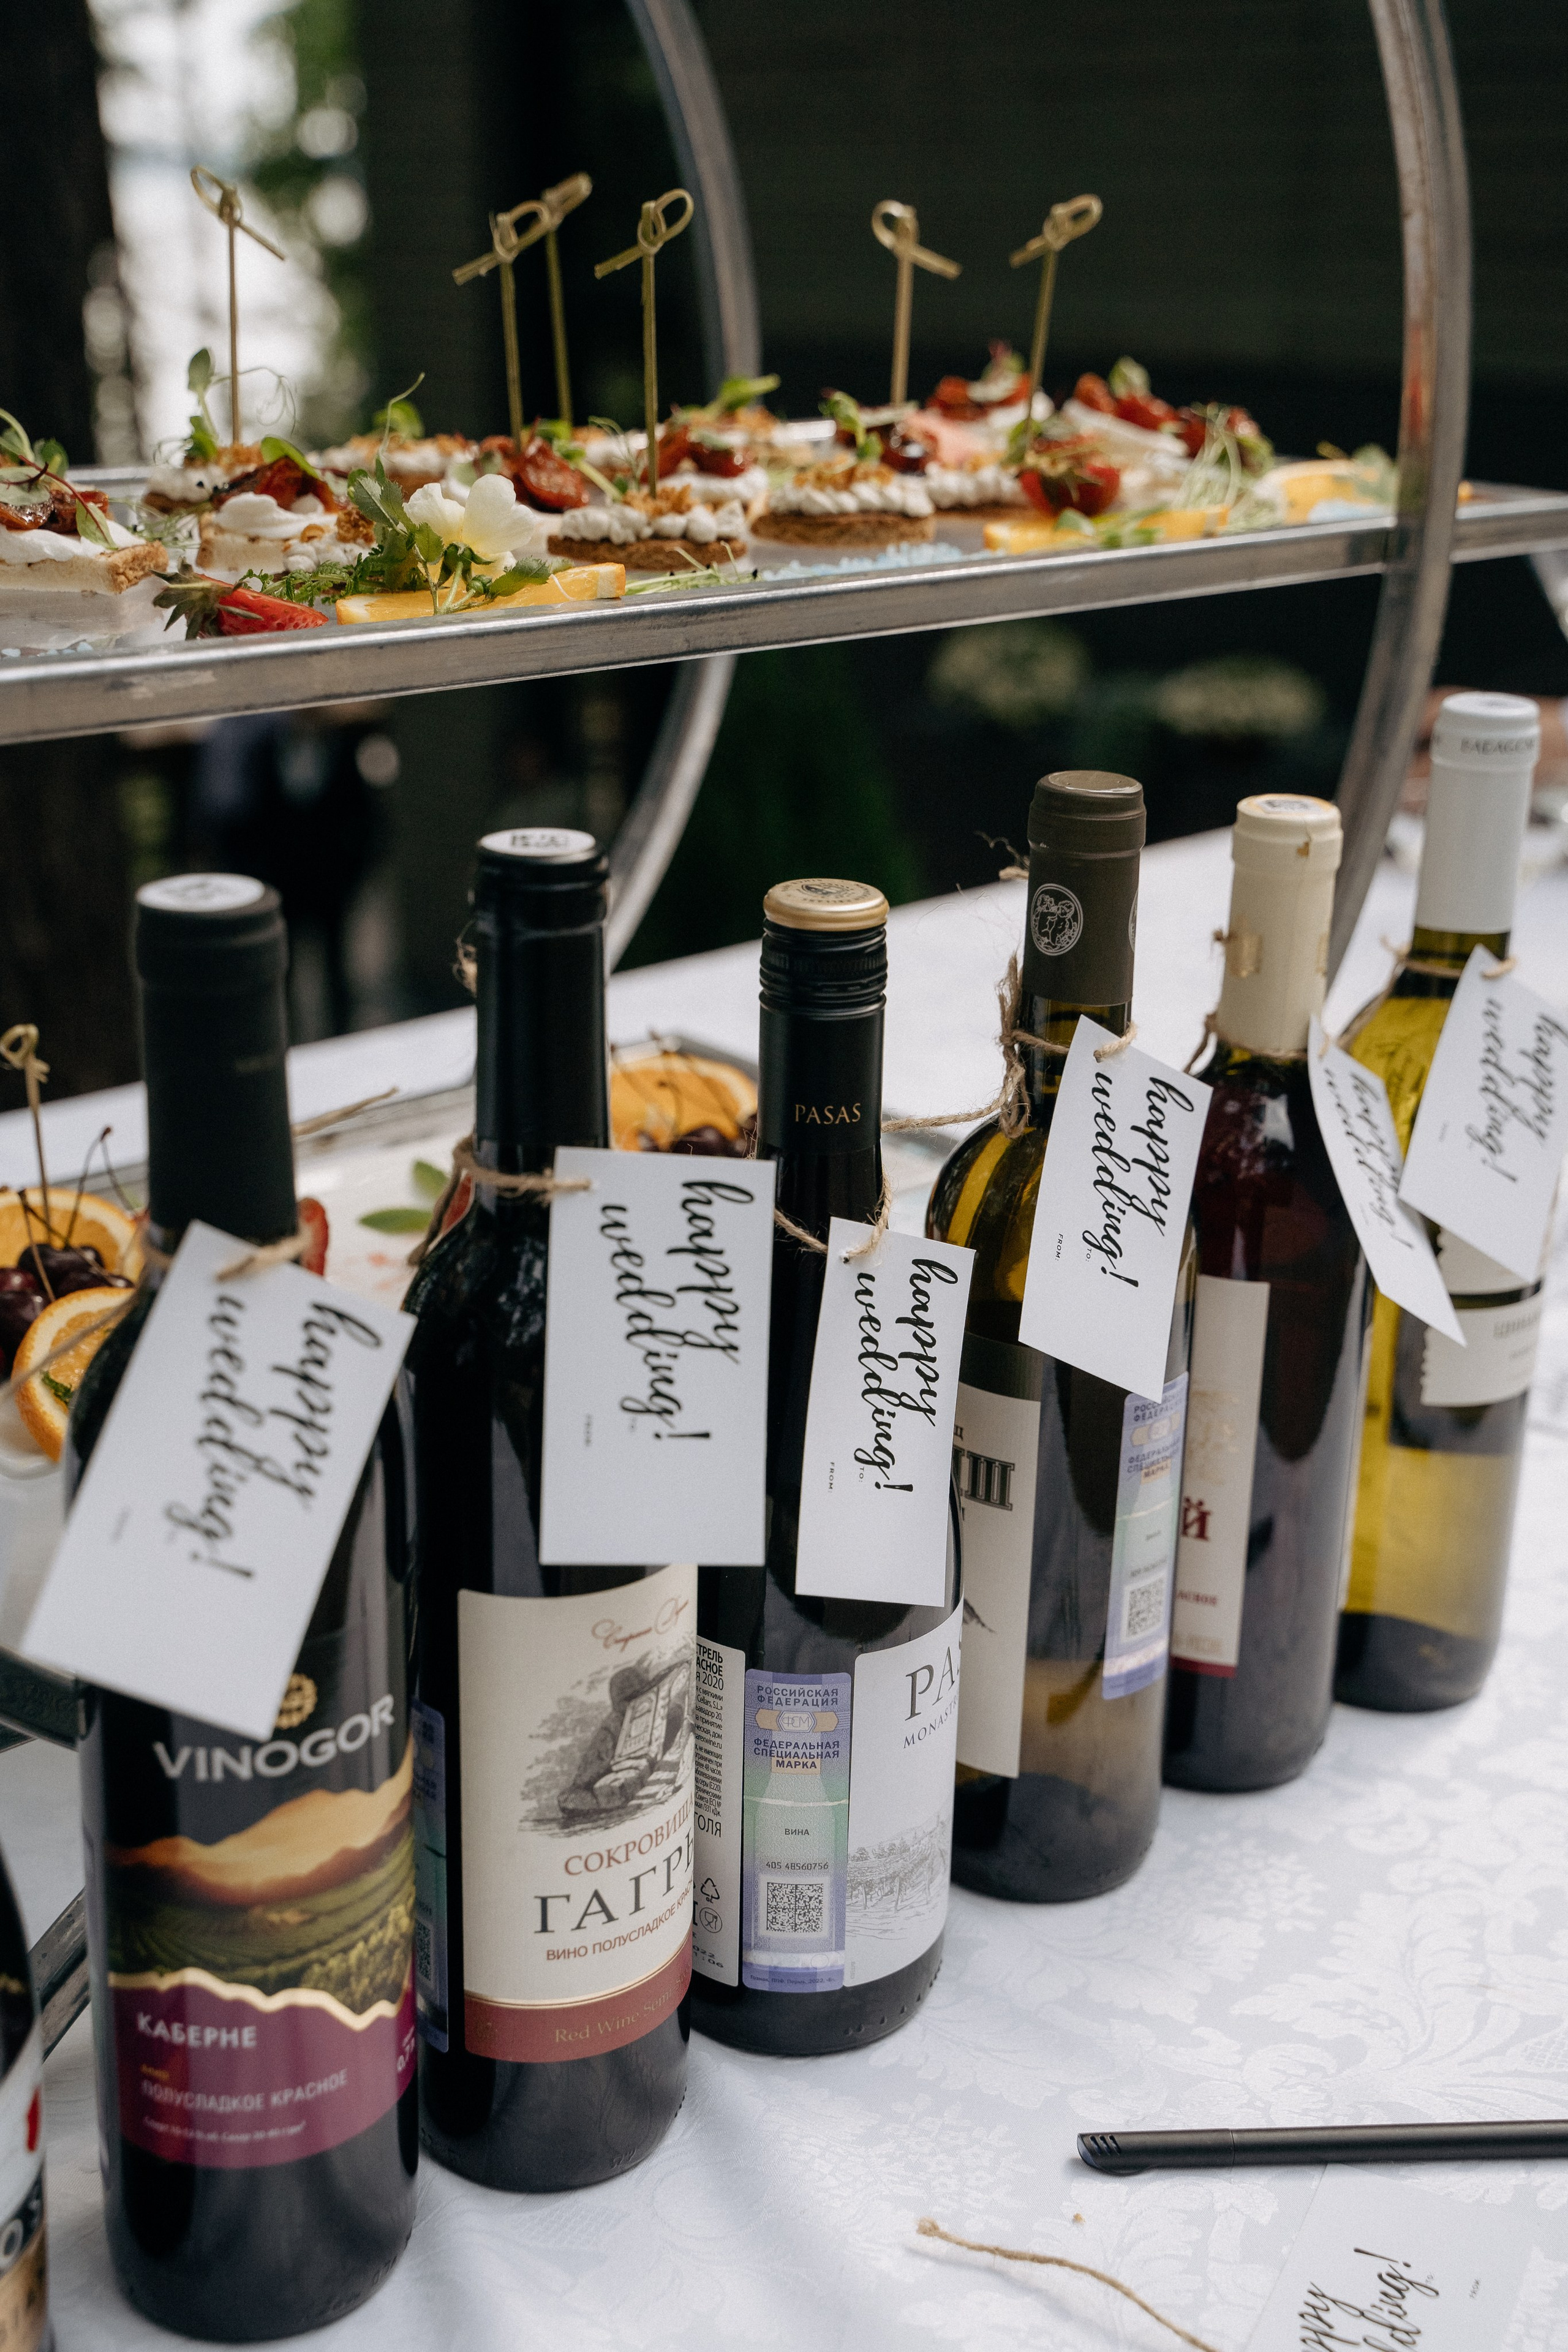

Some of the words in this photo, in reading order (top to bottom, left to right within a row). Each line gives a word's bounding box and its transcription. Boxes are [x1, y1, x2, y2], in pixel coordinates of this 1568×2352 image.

[796, 1103, 862, 1125] PASAS
[1130, 1076, 1194, 1237] happy
[1082, 1071, 1139, 1287] wedding!
[1055, 1233, 1063, 1261] FROM:
[666, 1181, 755, 1365] happy
[600, 1204, 710, 1440] wedding!
[895, 1258, 959, 1427] happy
[853, 1272, 914, 1492] wedding!
[262, 1301, 383, 1508] happy
[164, 1295, 268, 1578] wedding!
[696, 1643, 723, 1664] ТРЕЛЬ
[696, 1656, 723, 1677] АСНОЕ
[703, 1672, 724, 1691] 2020
[757, 1686, 839, 1698] РОССИЙСКАЯ
[905, 1646, 959, 1721] PA
[757, 1695, 839, 1707] ФЕДЕРАЦИЯ
[153, 1694, 395, 1782] VINOGOR
[695, 1724, 711, 1736] ческая,
[699, 1716, 722, 1730] принятие
[903, 1694, 957, 1749] MONASTR
[754, 1738, 839, 1750] ФЕДЕРАЛЬНАЯ
[754, 1747, 839, 1759] СПЕЦИАЛЬНАЯ
[776, 1760, 817, 1769] МАРКА
[785, 1862, 829, 1871] 48560756
[546, 1945, 588, 1961] ВИНО
[593, 1902, 676, 1954] ПОЛУСЛАДКОЕ
[137, 2011, 258, 2049] КАБЕРНЕ
[555, 2026, 590, 2043] Red
[141, 2080, 265, 2113] ПОЛУСЛАДКОЕ
[271, 2068, 348, 2106] КРАСНОЕ
